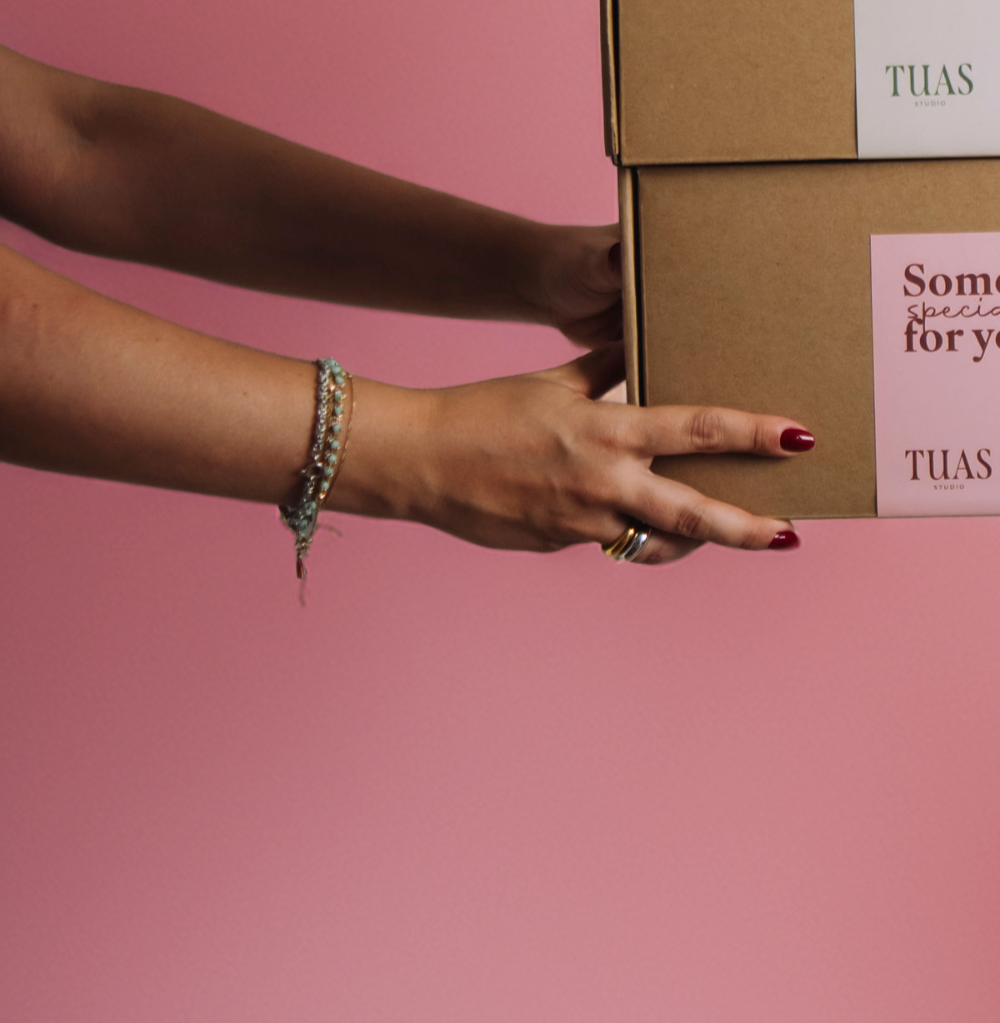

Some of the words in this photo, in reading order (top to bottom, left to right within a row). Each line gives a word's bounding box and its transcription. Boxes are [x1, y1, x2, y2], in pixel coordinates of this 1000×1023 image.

[885, 63, 974, 97] TUAS
[904, 318, 964, 353] for
[904, 448, 993, 481] TUAS
